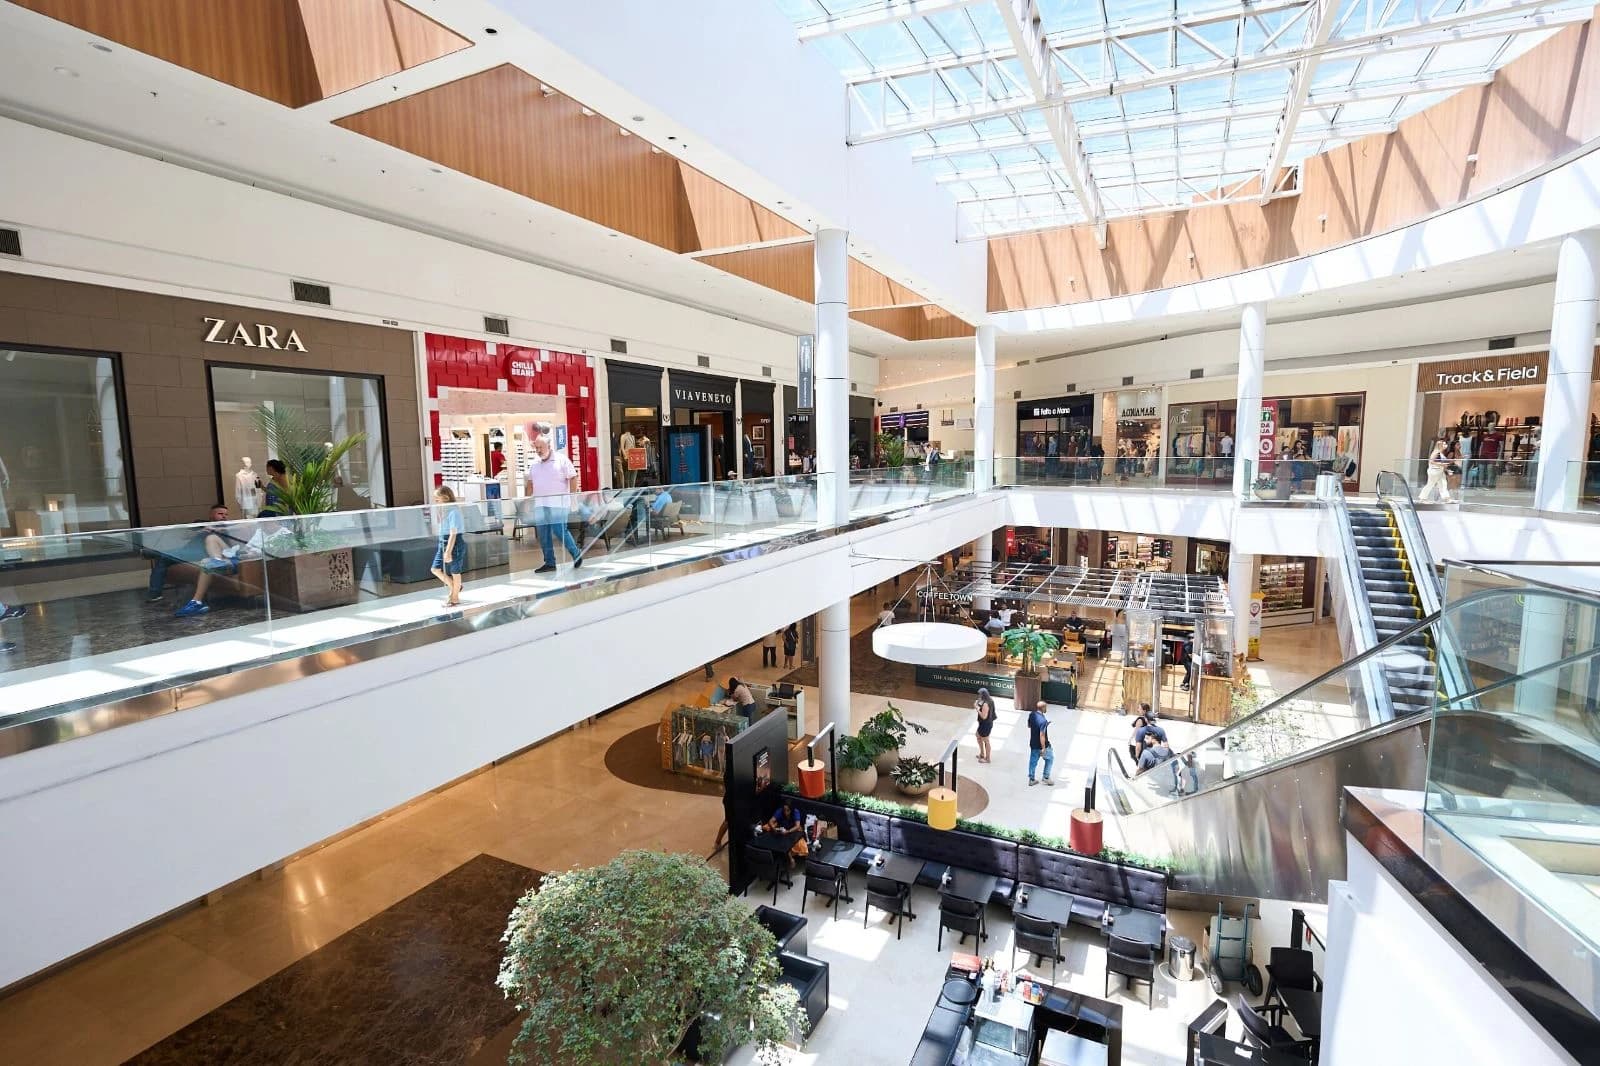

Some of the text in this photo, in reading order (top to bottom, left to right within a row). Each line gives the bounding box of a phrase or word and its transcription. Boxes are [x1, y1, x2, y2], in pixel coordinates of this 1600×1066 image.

[204, 317, 309, 353] ZARA
[512, 361, 534, 370] CHILLI
[511, 368, 535, 377] BEANS
